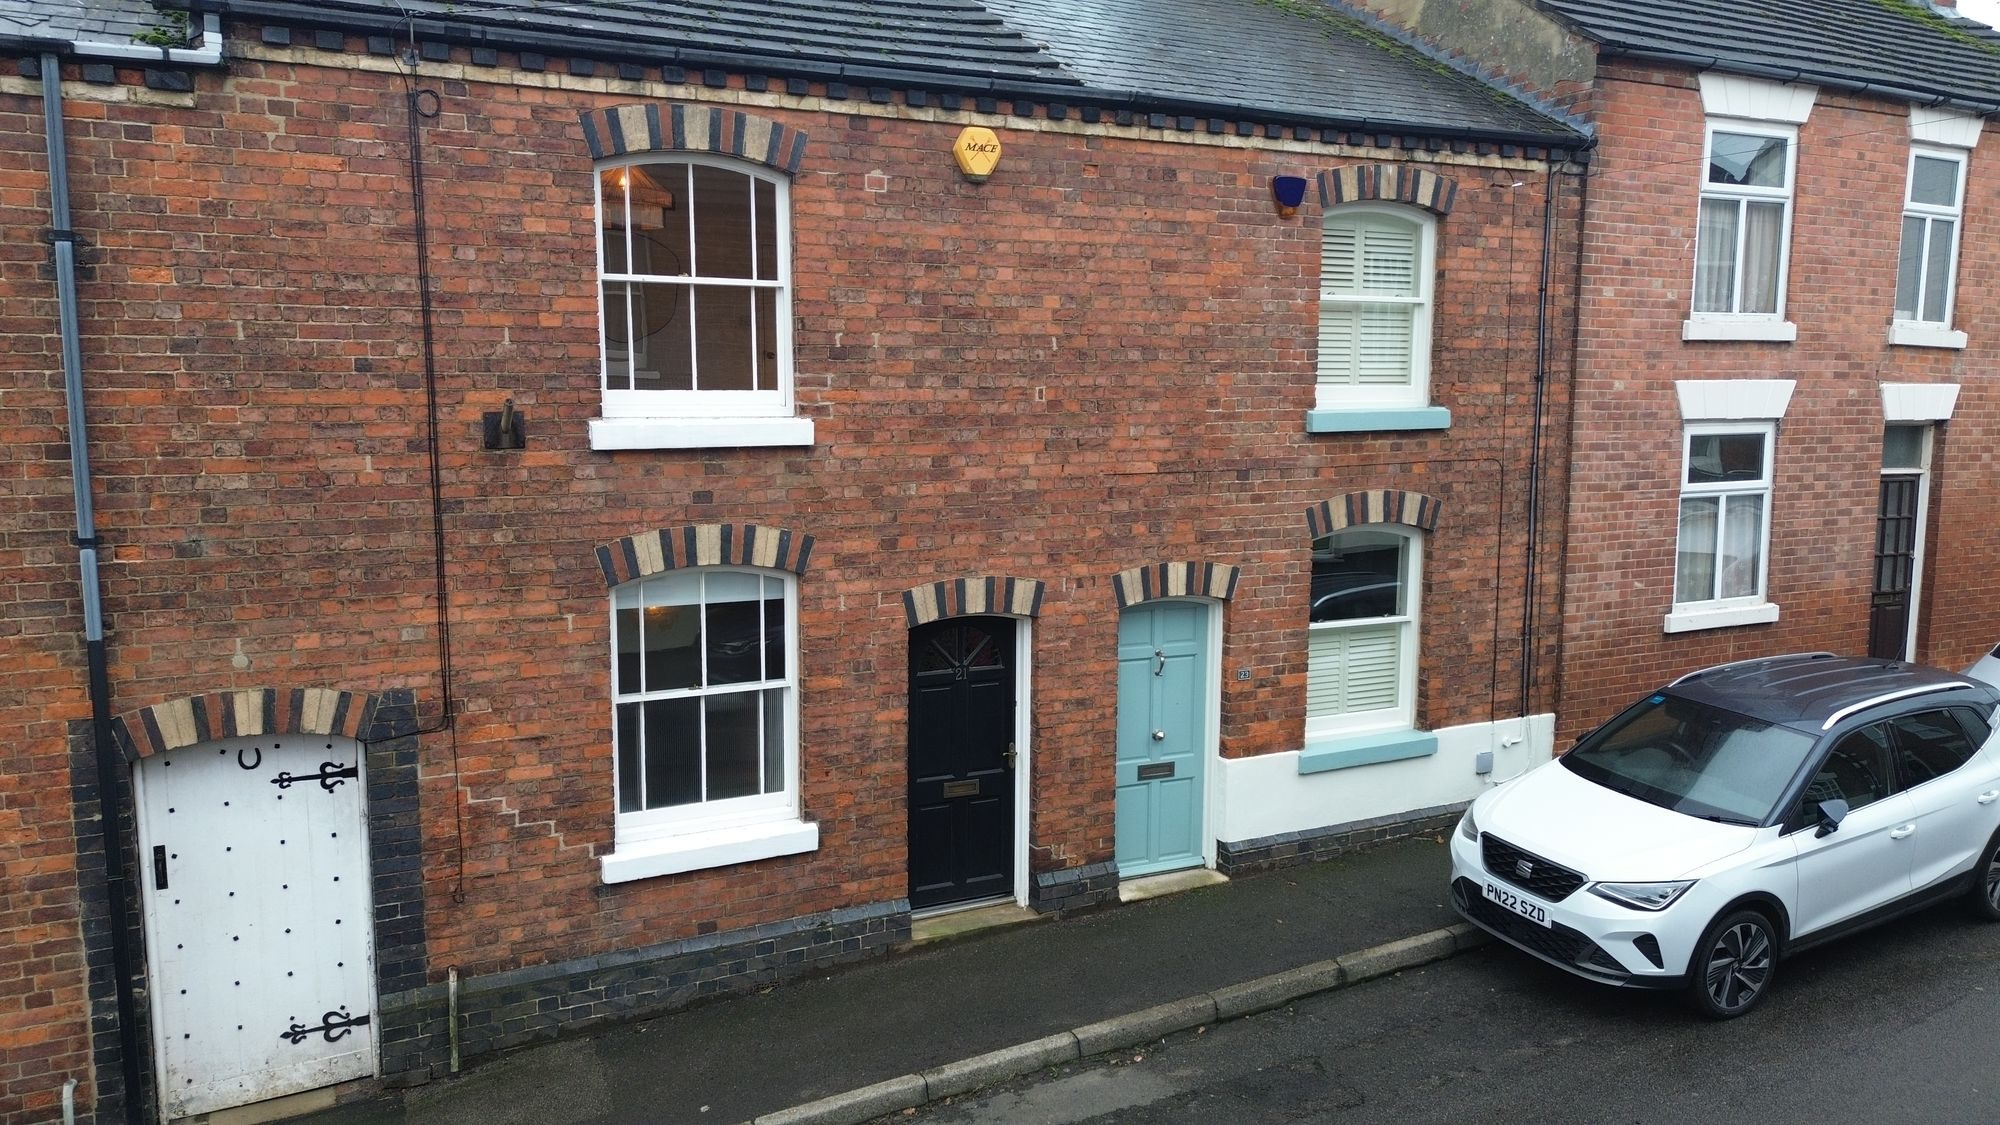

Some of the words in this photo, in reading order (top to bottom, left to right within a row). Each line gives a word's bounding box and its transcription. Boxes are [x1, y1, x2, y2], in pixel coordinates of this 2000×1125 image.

[965, 142, 998, 153] MACE
[955, 667, 967, 680] 21
[1240, 671, 1249, 679] 23
[1487, 883, 1517, 910] PN22
[1520, 899, 1545, 923] SZD
